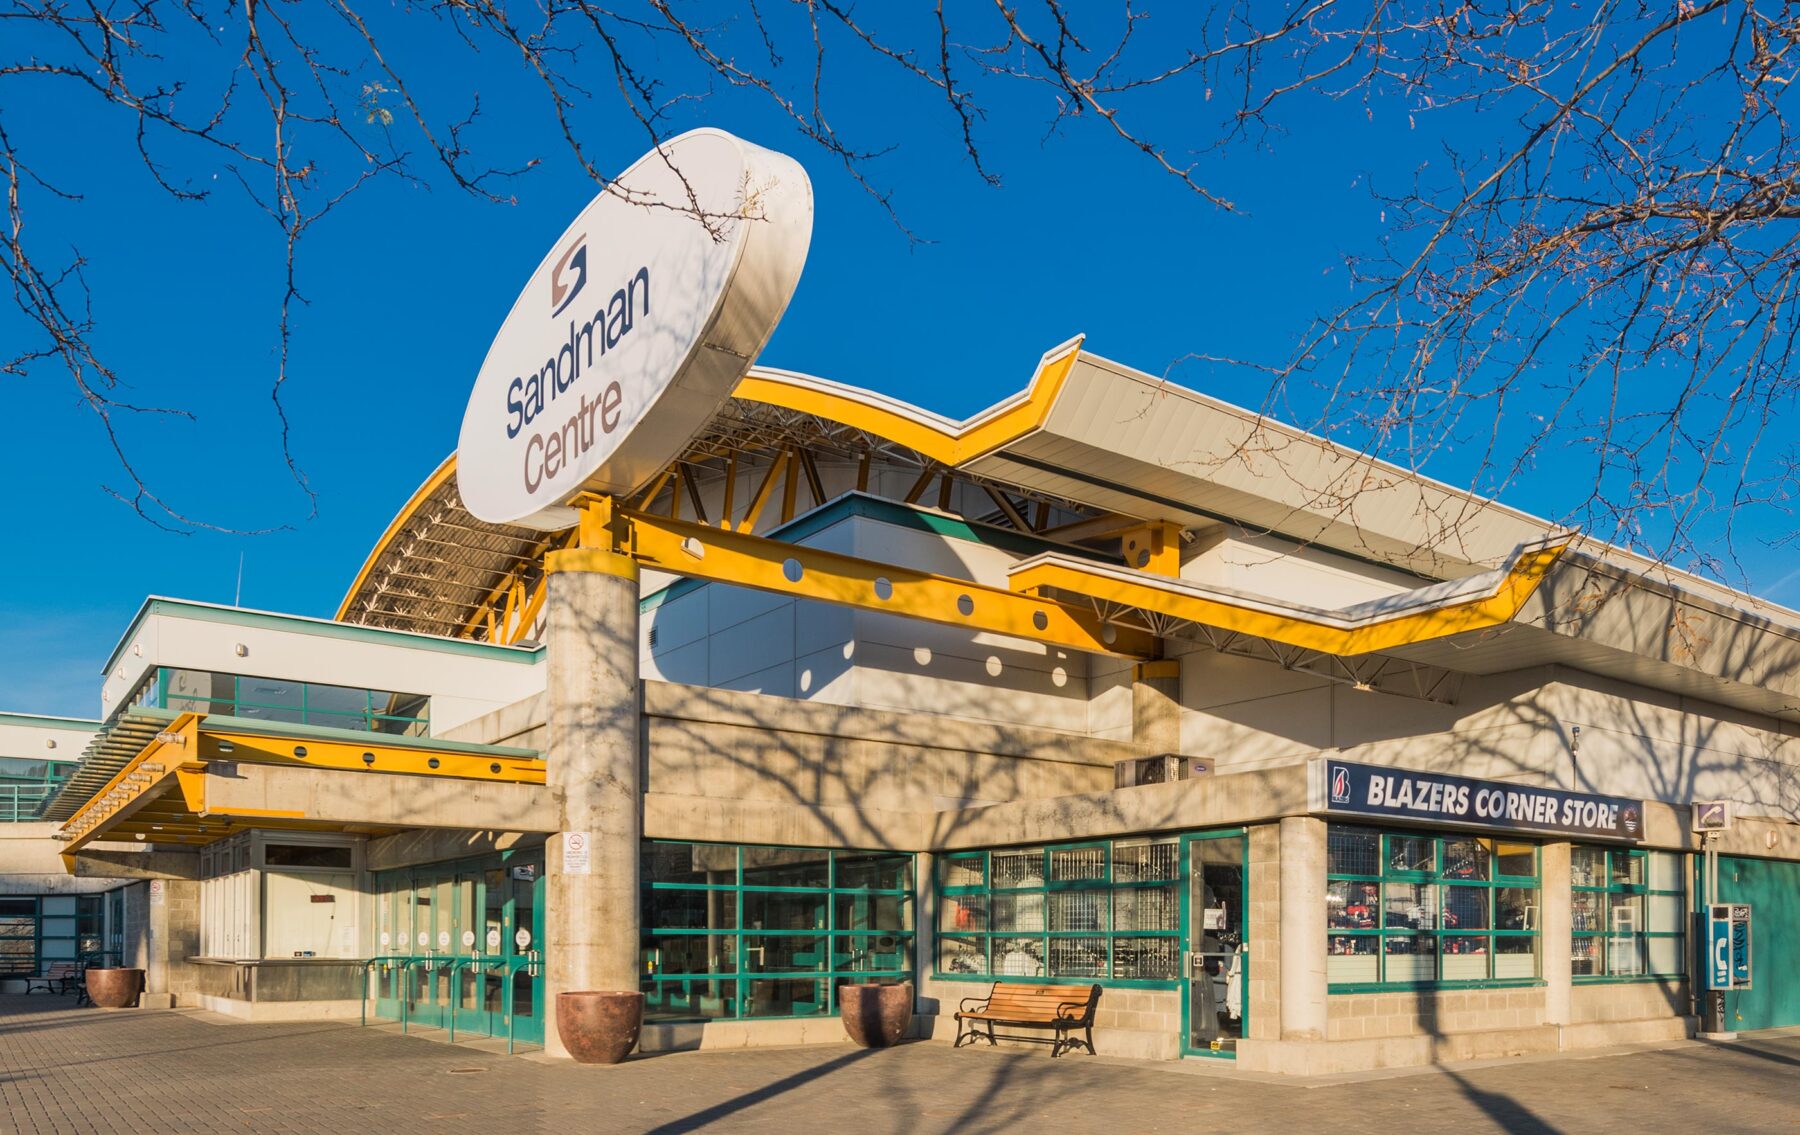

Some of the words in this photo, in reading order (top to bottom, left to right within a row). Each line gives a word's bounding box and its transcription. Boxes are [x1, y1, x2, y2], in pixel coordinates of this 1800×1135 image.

[506, 266, 649, 440] Sandman
[524, 380, 622, 495] Centre
[1367, 775, 1470, 816] BLAZERS
[1475, 788, 1557, 825] CORNER
[1561, 797, 1618, 830] STORE
